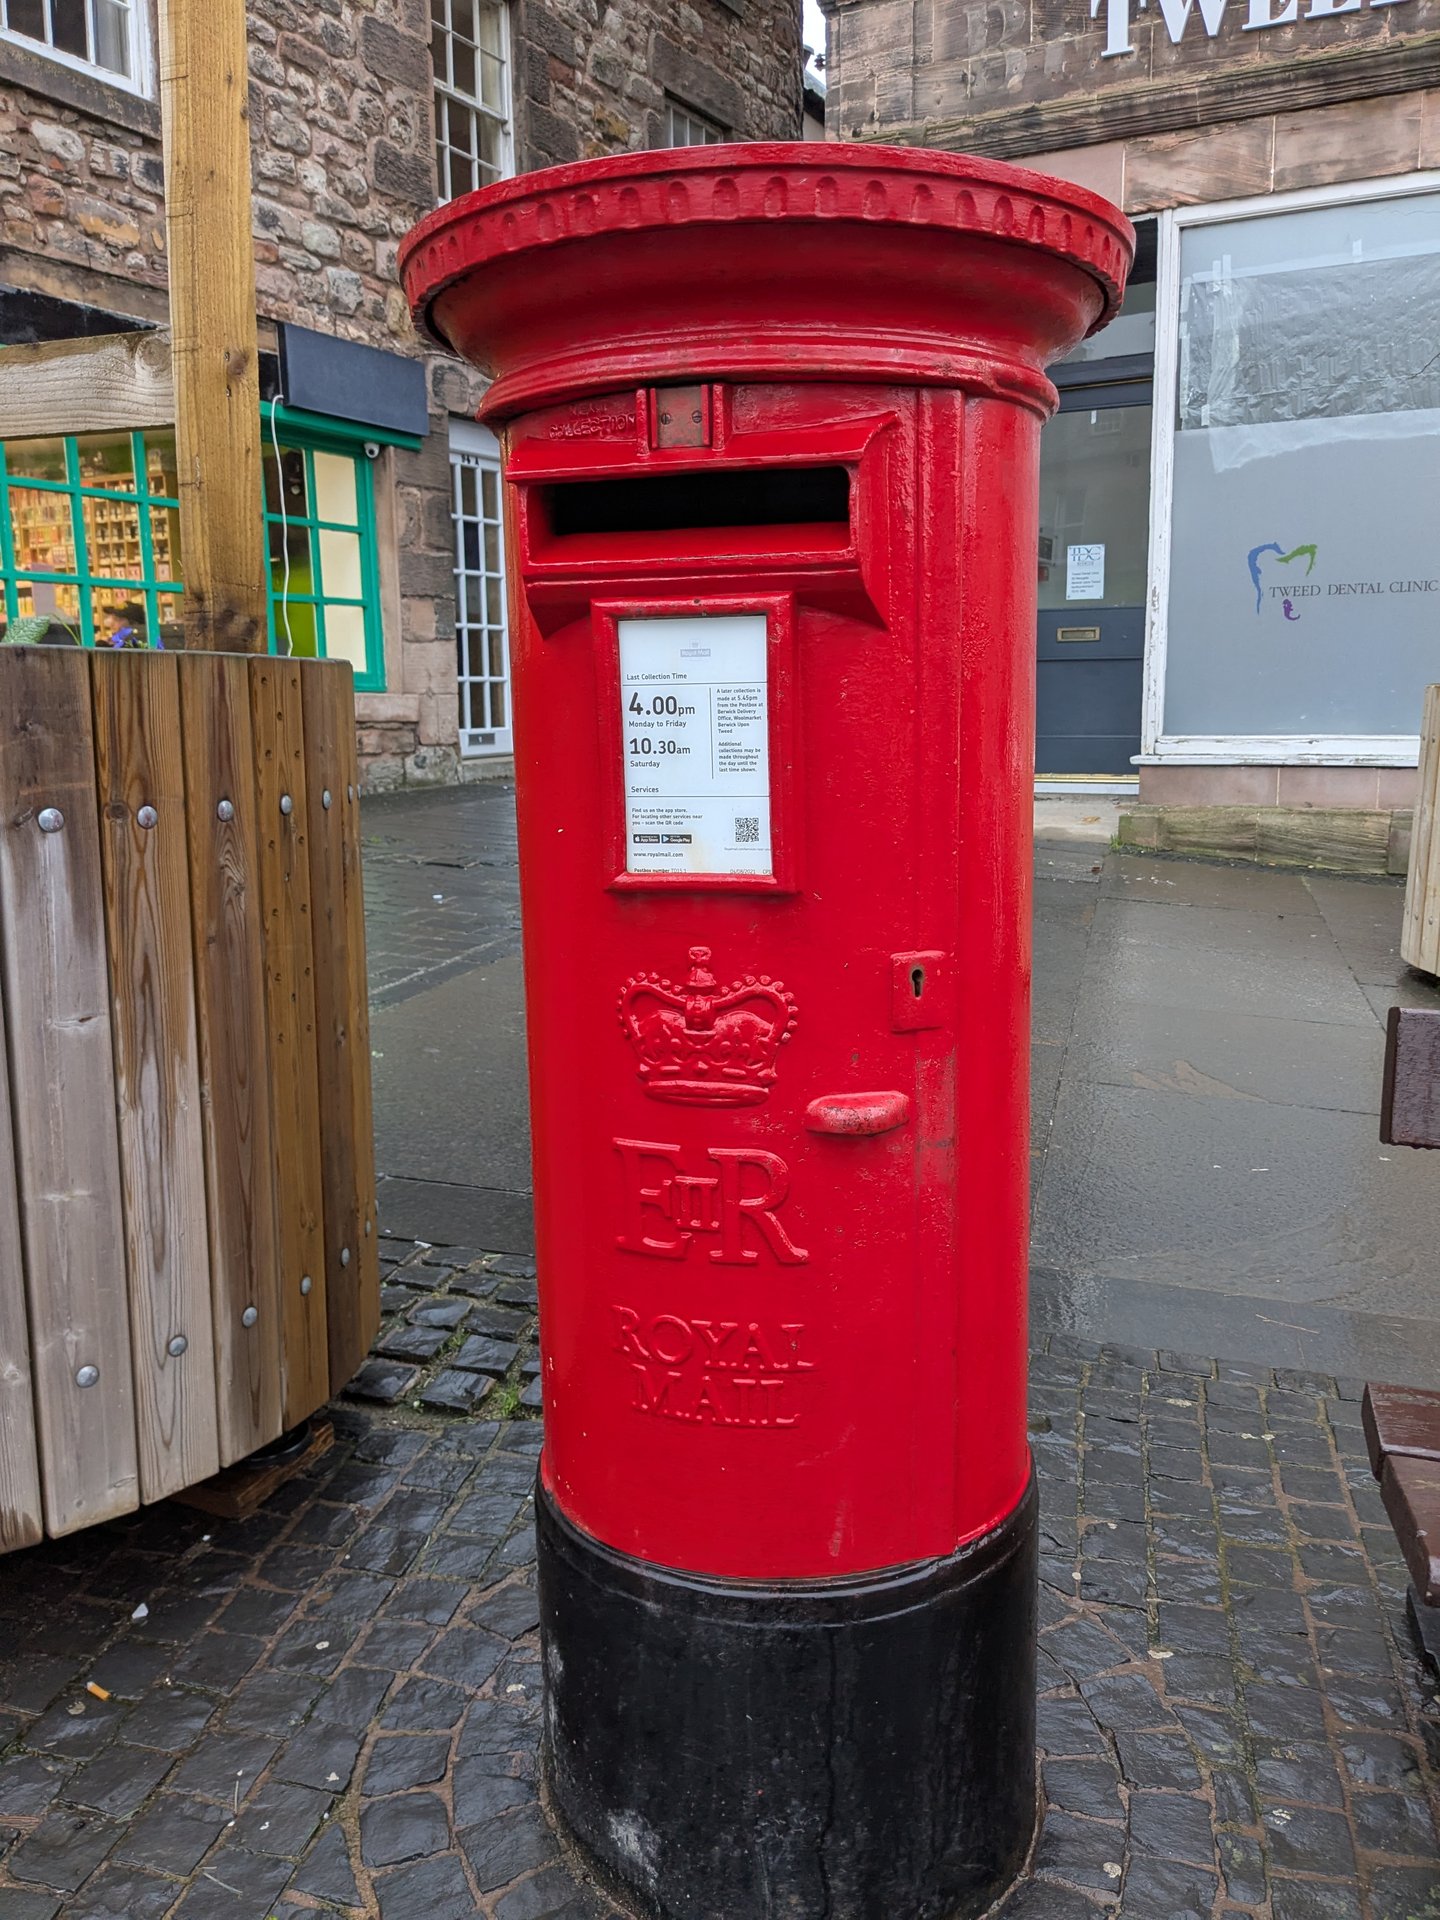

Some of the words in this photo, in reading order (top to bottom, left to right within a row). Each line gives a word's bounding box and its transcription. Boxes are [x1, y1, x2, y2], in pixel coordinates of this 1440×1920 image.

[1269, 585, 1321, 598] TWEED
[1328, 583, 1385, 596] DENTAL
[1389, 580, 1439, 593] CLINIC
[629, 692, 695, 716] 4.00pm
[629, 720, 655, 729] Monday
[666, 719, 687, 727] Friday
[629, 737, 691, 754] 10.30am
[630, 760, 661, 769] Saturday
[610, 1304, 820, 1372] ROYAL
[630, 1362, 802, 1428] MAIL
